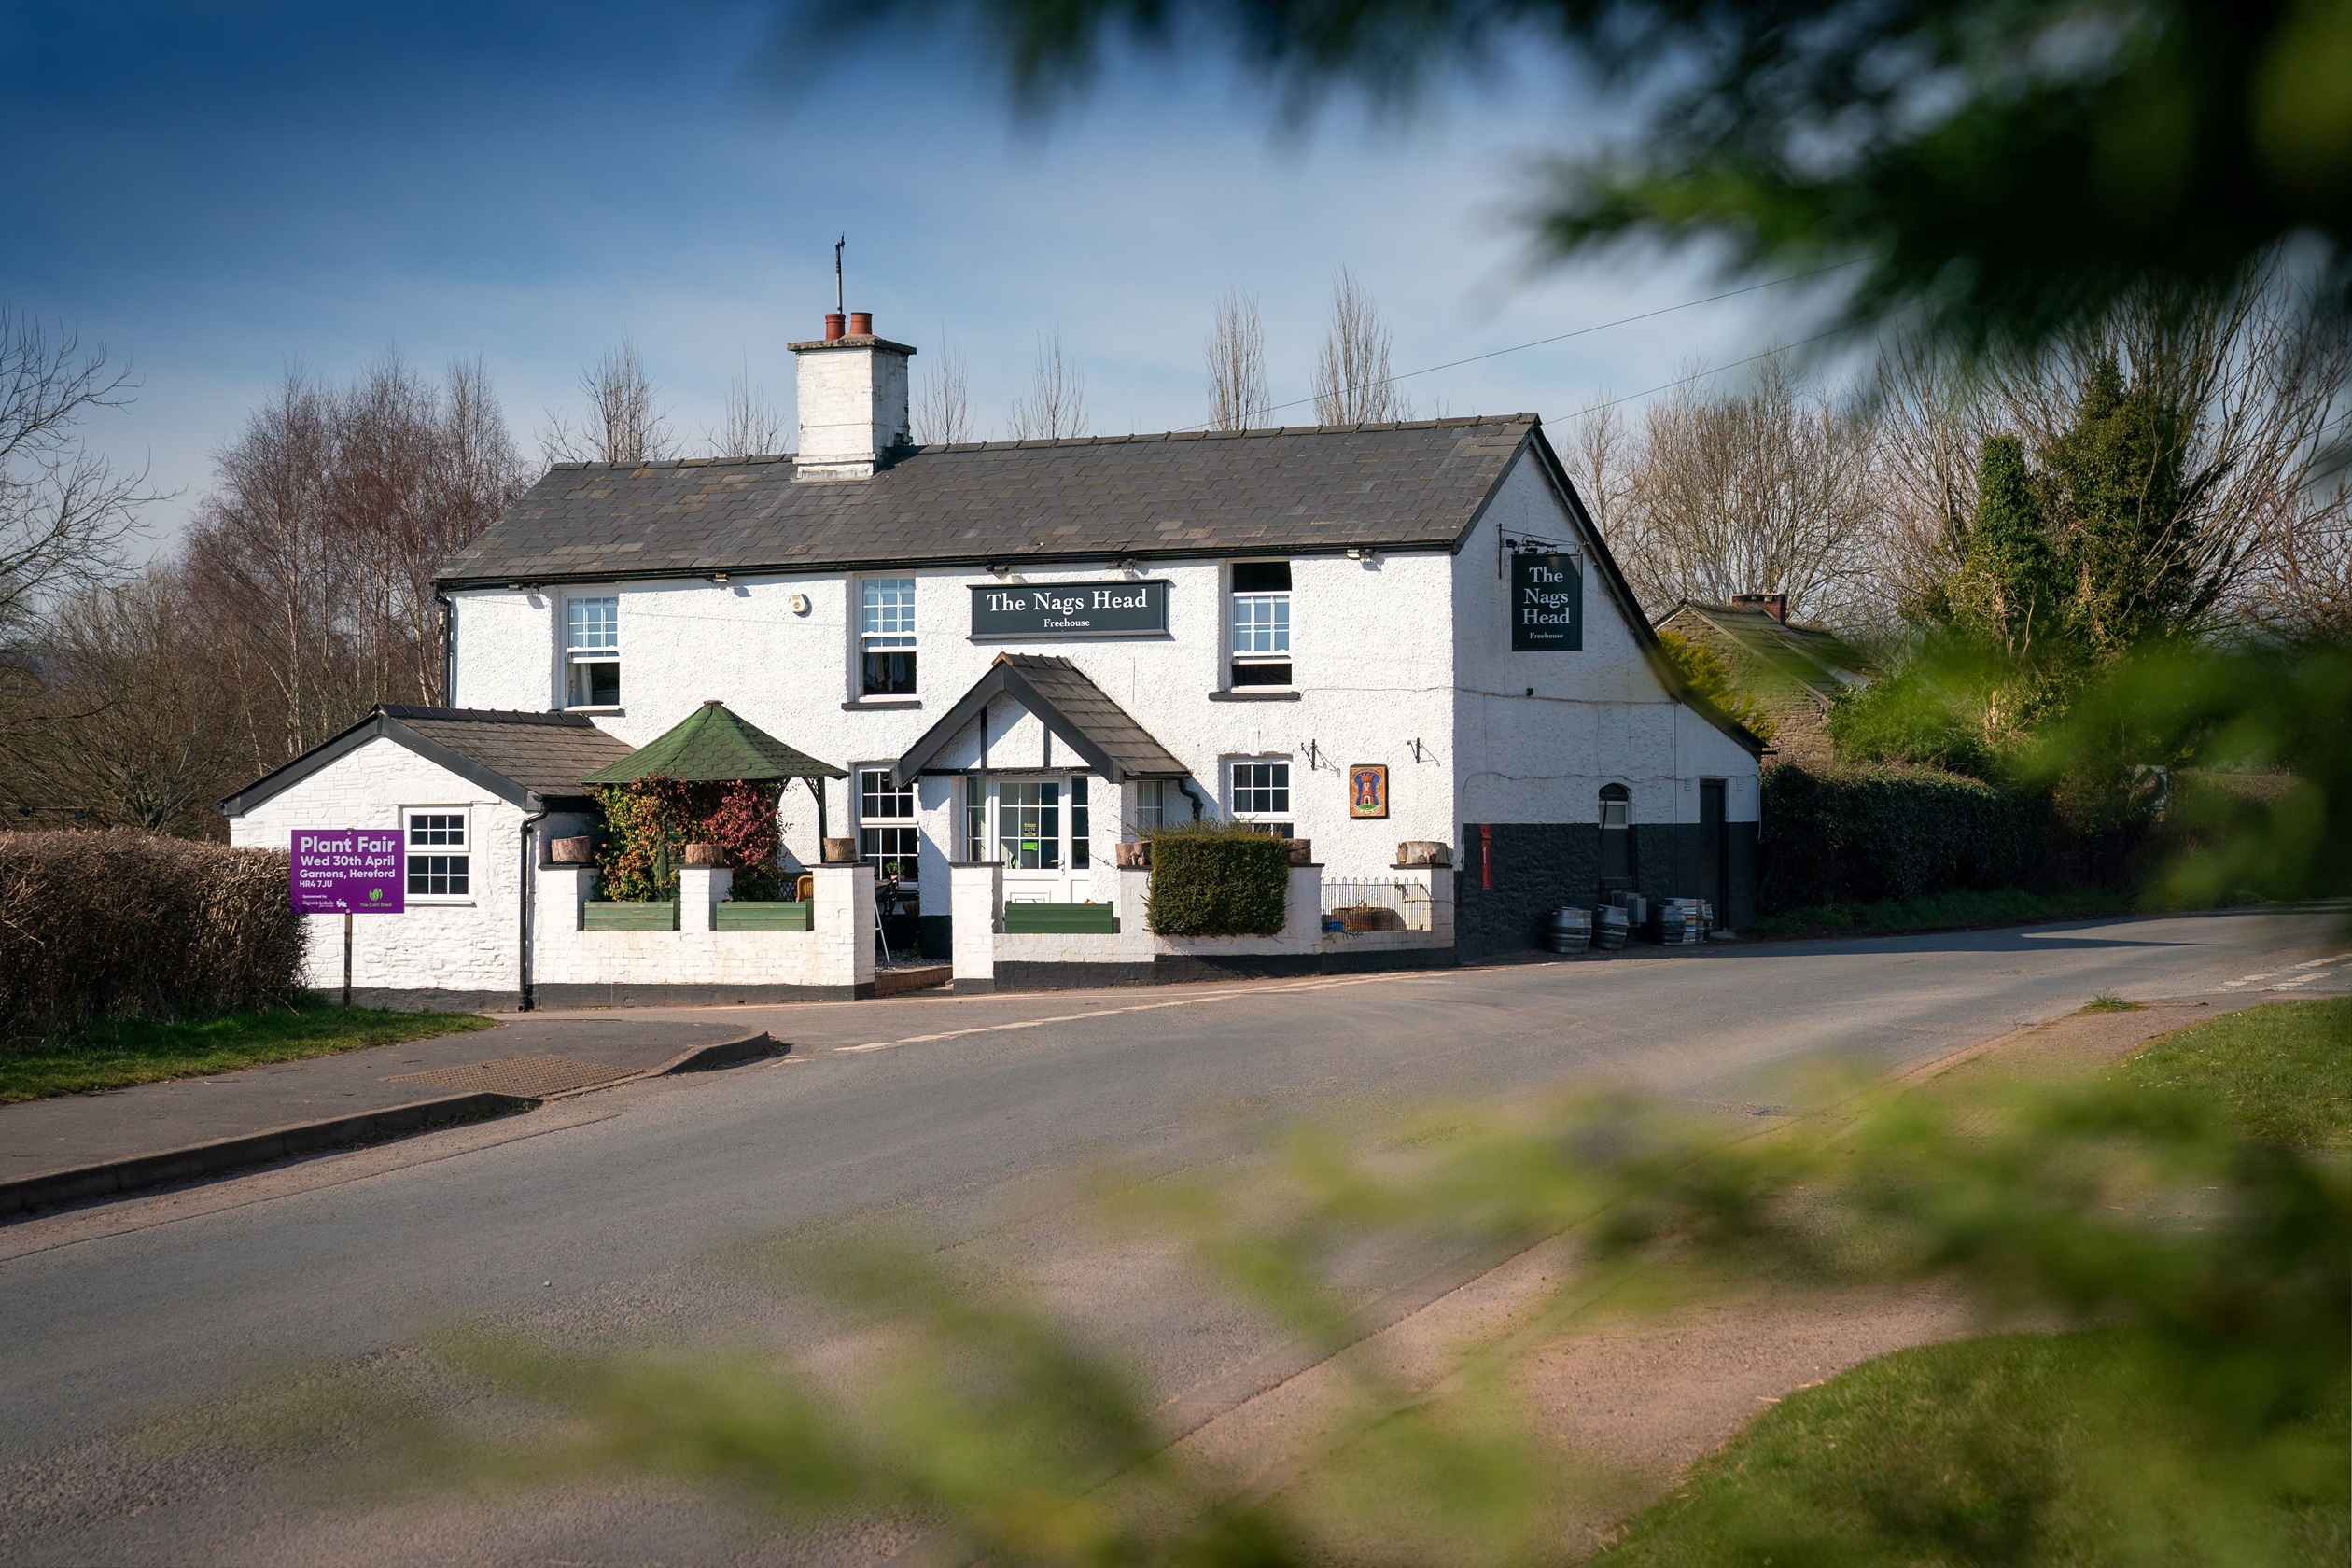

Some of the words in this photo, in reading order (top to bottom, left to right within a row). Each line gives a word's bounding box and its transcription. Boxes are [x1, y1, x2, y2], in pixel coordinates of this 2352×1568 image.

[1529, 566, 1564, 583] The
[987, 592, 1026, 611] The
[1032, 592, 1085, 615] Nags
[1092, 588, 1148, 609] Head
[1523, 587, 1569, 609] Nags
[1043, 617, 1090, 628] Freehouse
[1521, 607, 1571, 625] Head
[301, 836, 352, 853] Plant
[357, 836, 396, 853] Fair
[300, 855, 330, 866] Wed
[332, 855, 362, 866] 30th
[364, 855, 395, 868] April
[299, 869, 347, 879] Garnons,
[349, 869, 396, 878] Hereford
